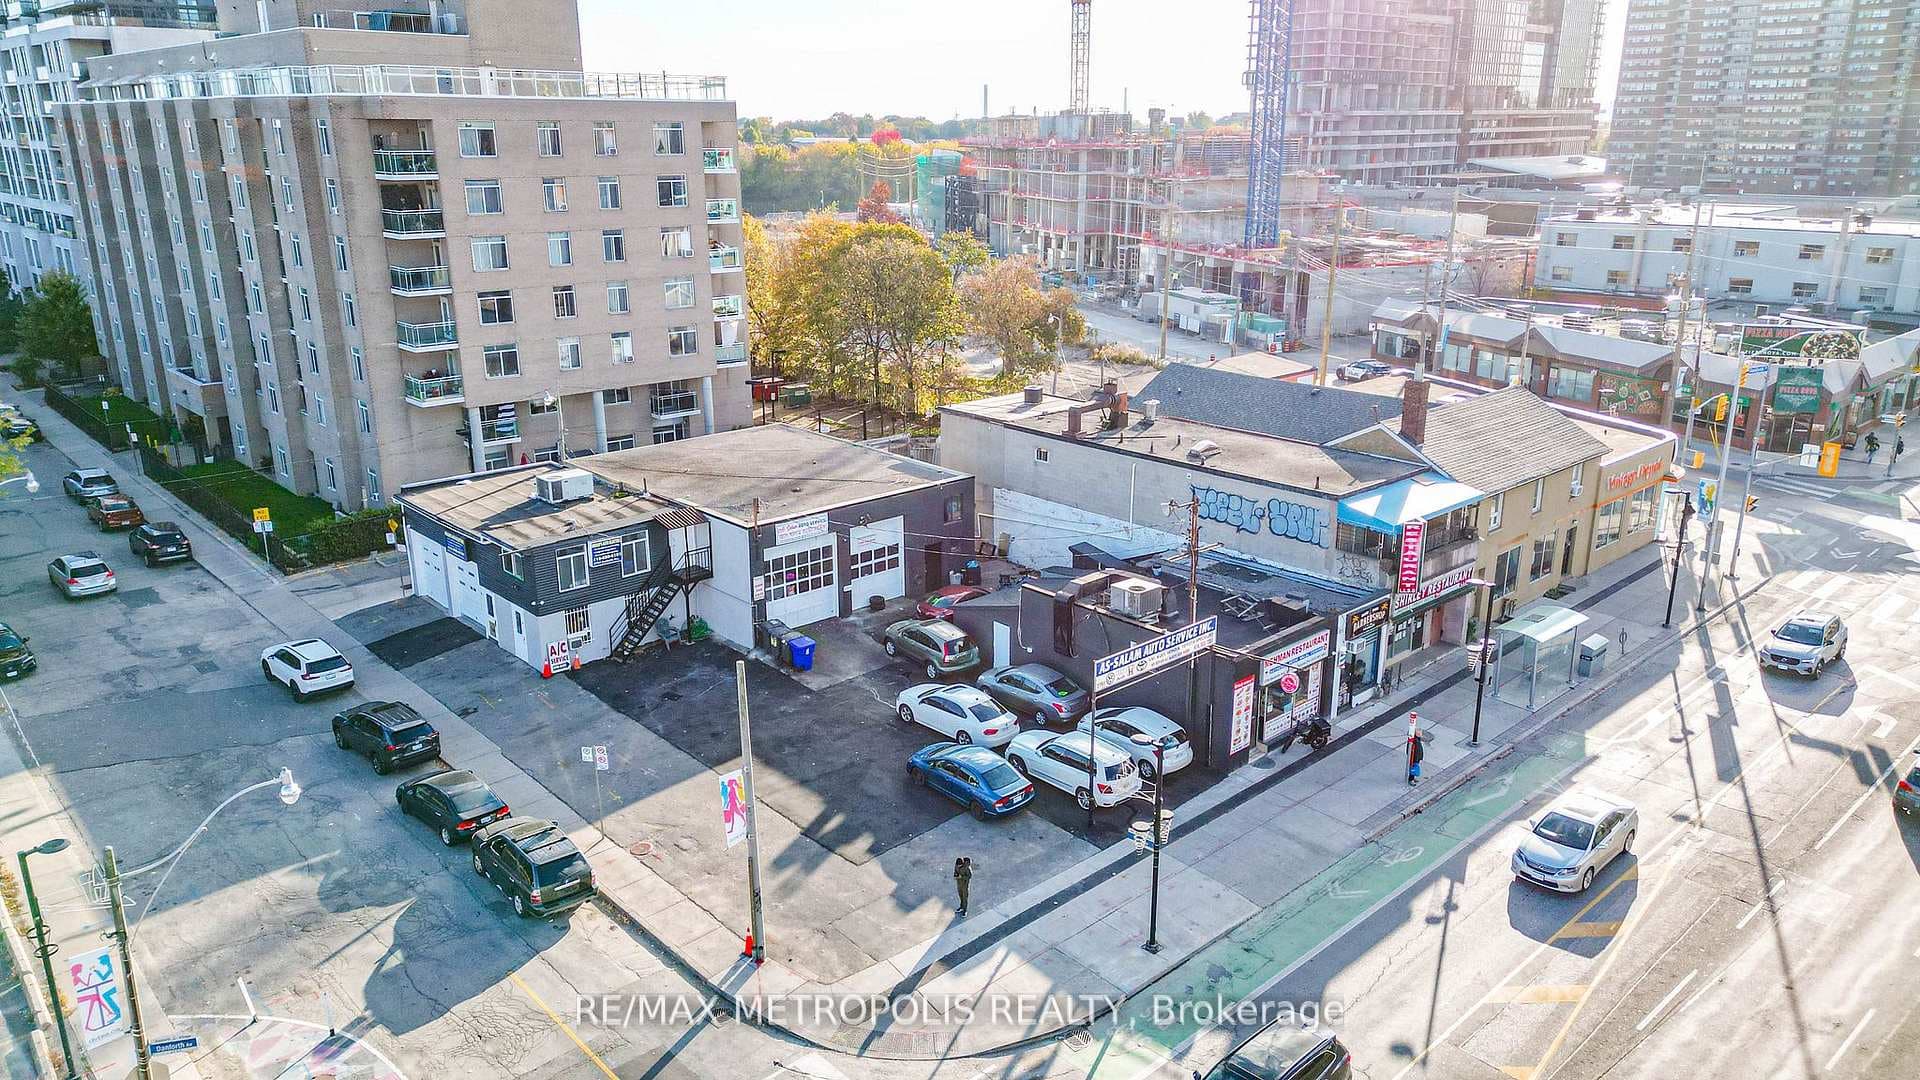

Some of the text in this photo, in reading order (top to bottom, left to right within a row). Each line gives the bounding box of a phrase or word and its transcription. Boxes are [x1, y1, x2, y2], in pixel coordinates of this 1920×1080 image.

[1428, 567, 1474, 595] RESTAURANT
[550, 642, 567, 656] A/C
[1099, 647, 1142, 674] AS-SALAM
[1143, 639, 1165, 657] AUTO
[1166, 626, 1199, 648] SERVICE
[1199, 620, 1214, 635] INC.
[1291, 633, 1328, 656] RESTAURANT
[156, 1042, 185, 1051] Danforth
